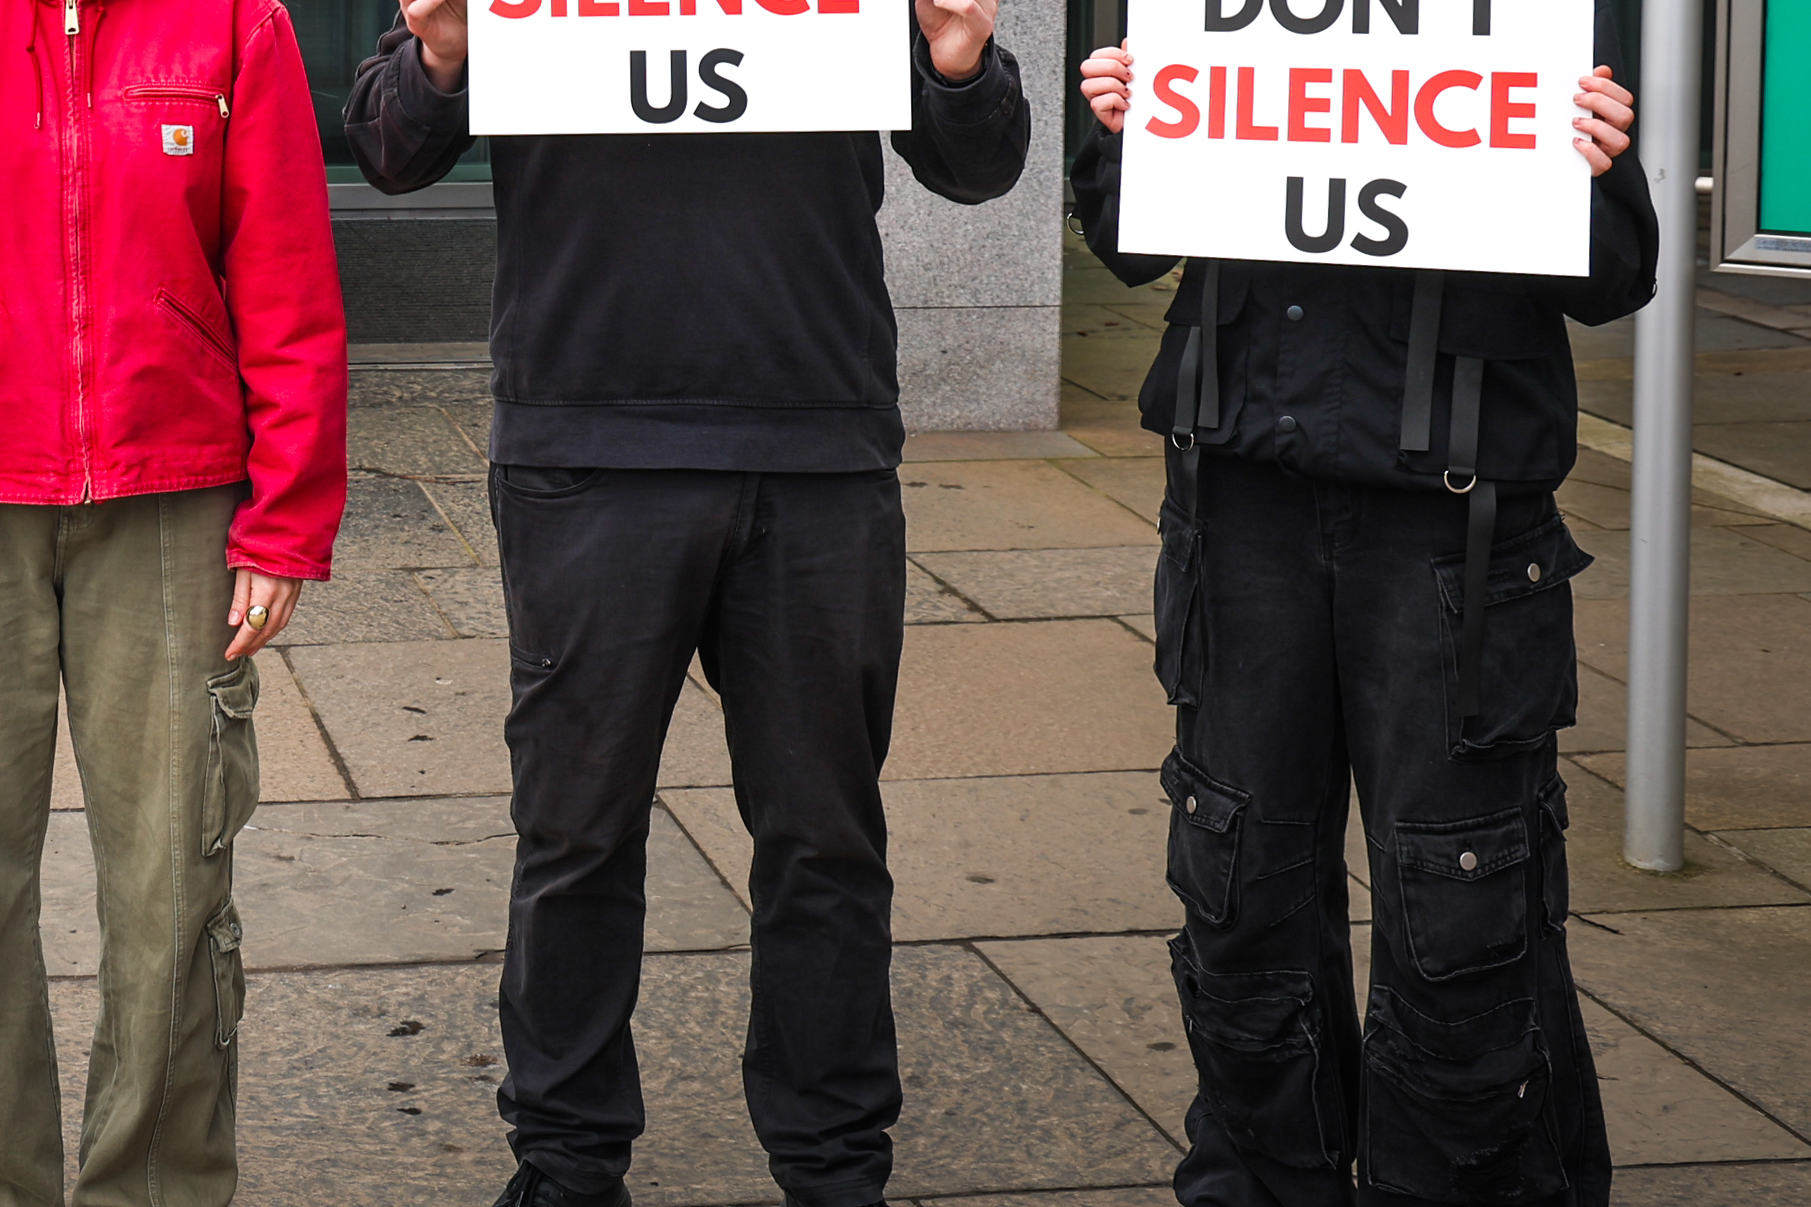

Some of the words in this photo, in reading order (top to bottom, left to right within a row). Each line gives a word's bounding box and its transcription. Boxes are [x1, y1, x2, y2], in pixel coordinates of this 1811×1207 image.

[629, 48, 748, 124] US
[1144, 63, 1538, 150] SILENCE
[1284, 176, 1409, 257] US
